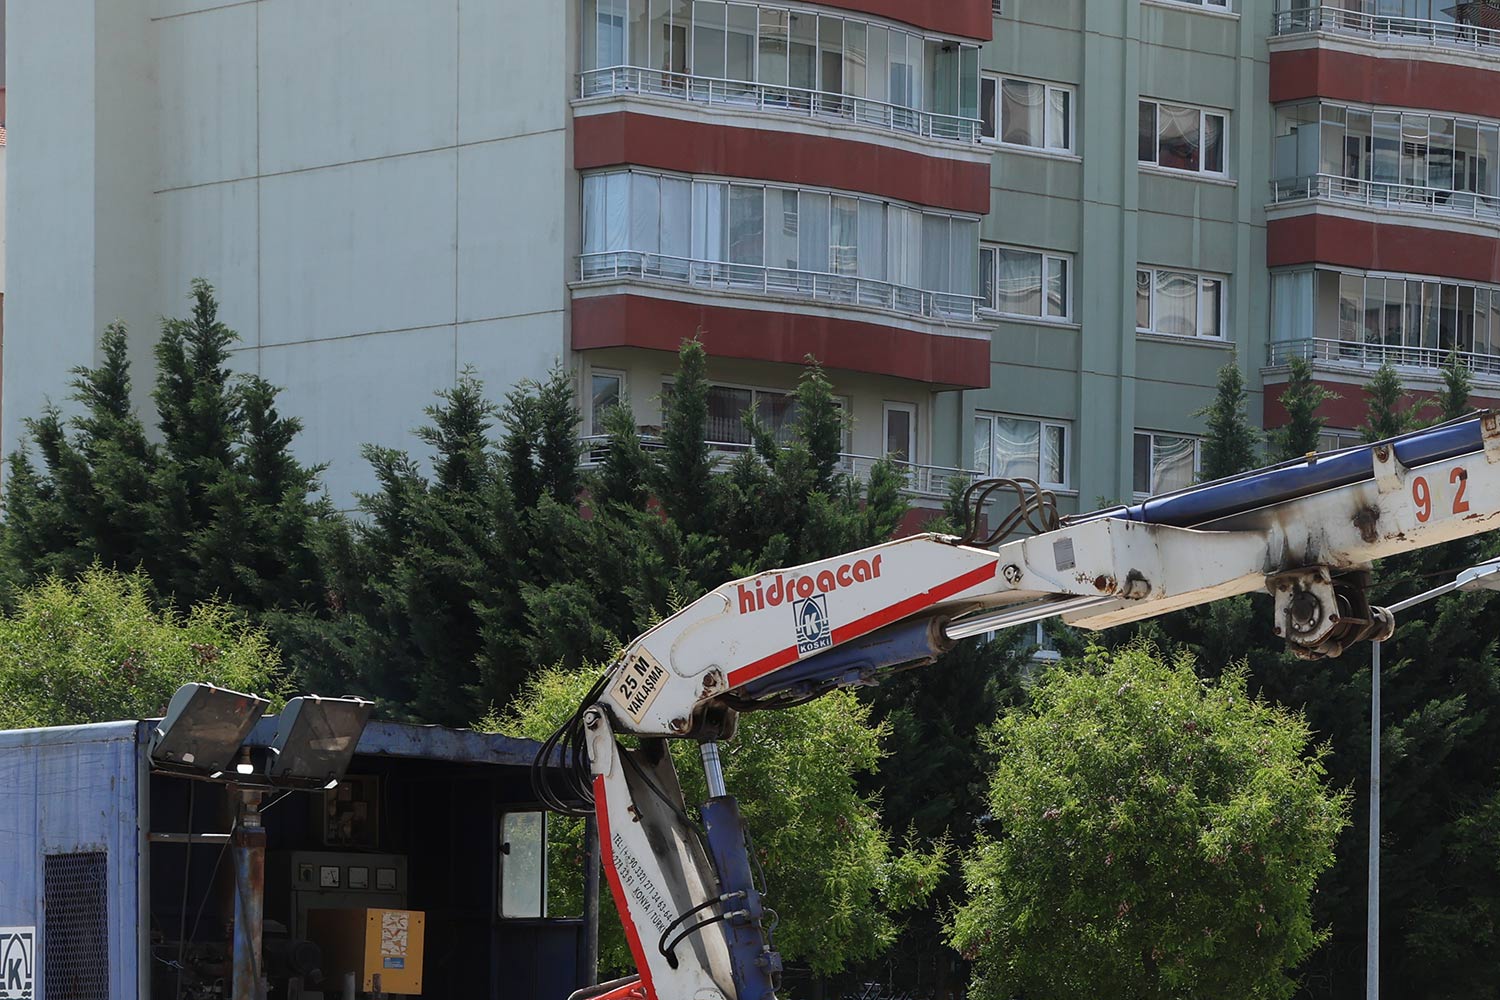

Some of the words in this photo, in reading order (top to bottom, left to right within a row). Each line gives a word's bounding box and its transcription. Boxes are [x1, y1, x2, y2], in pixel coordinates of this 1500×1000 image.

[737, 553, 883, 615] hidroacar
[619, 674, 638, 700] 25
[633, 655, 650, 677] M
[627, 665, 664, 716] YAKLAŞMA
[632, 885, 652, 912] KONYA
[651, 891, 661, 903] 34
